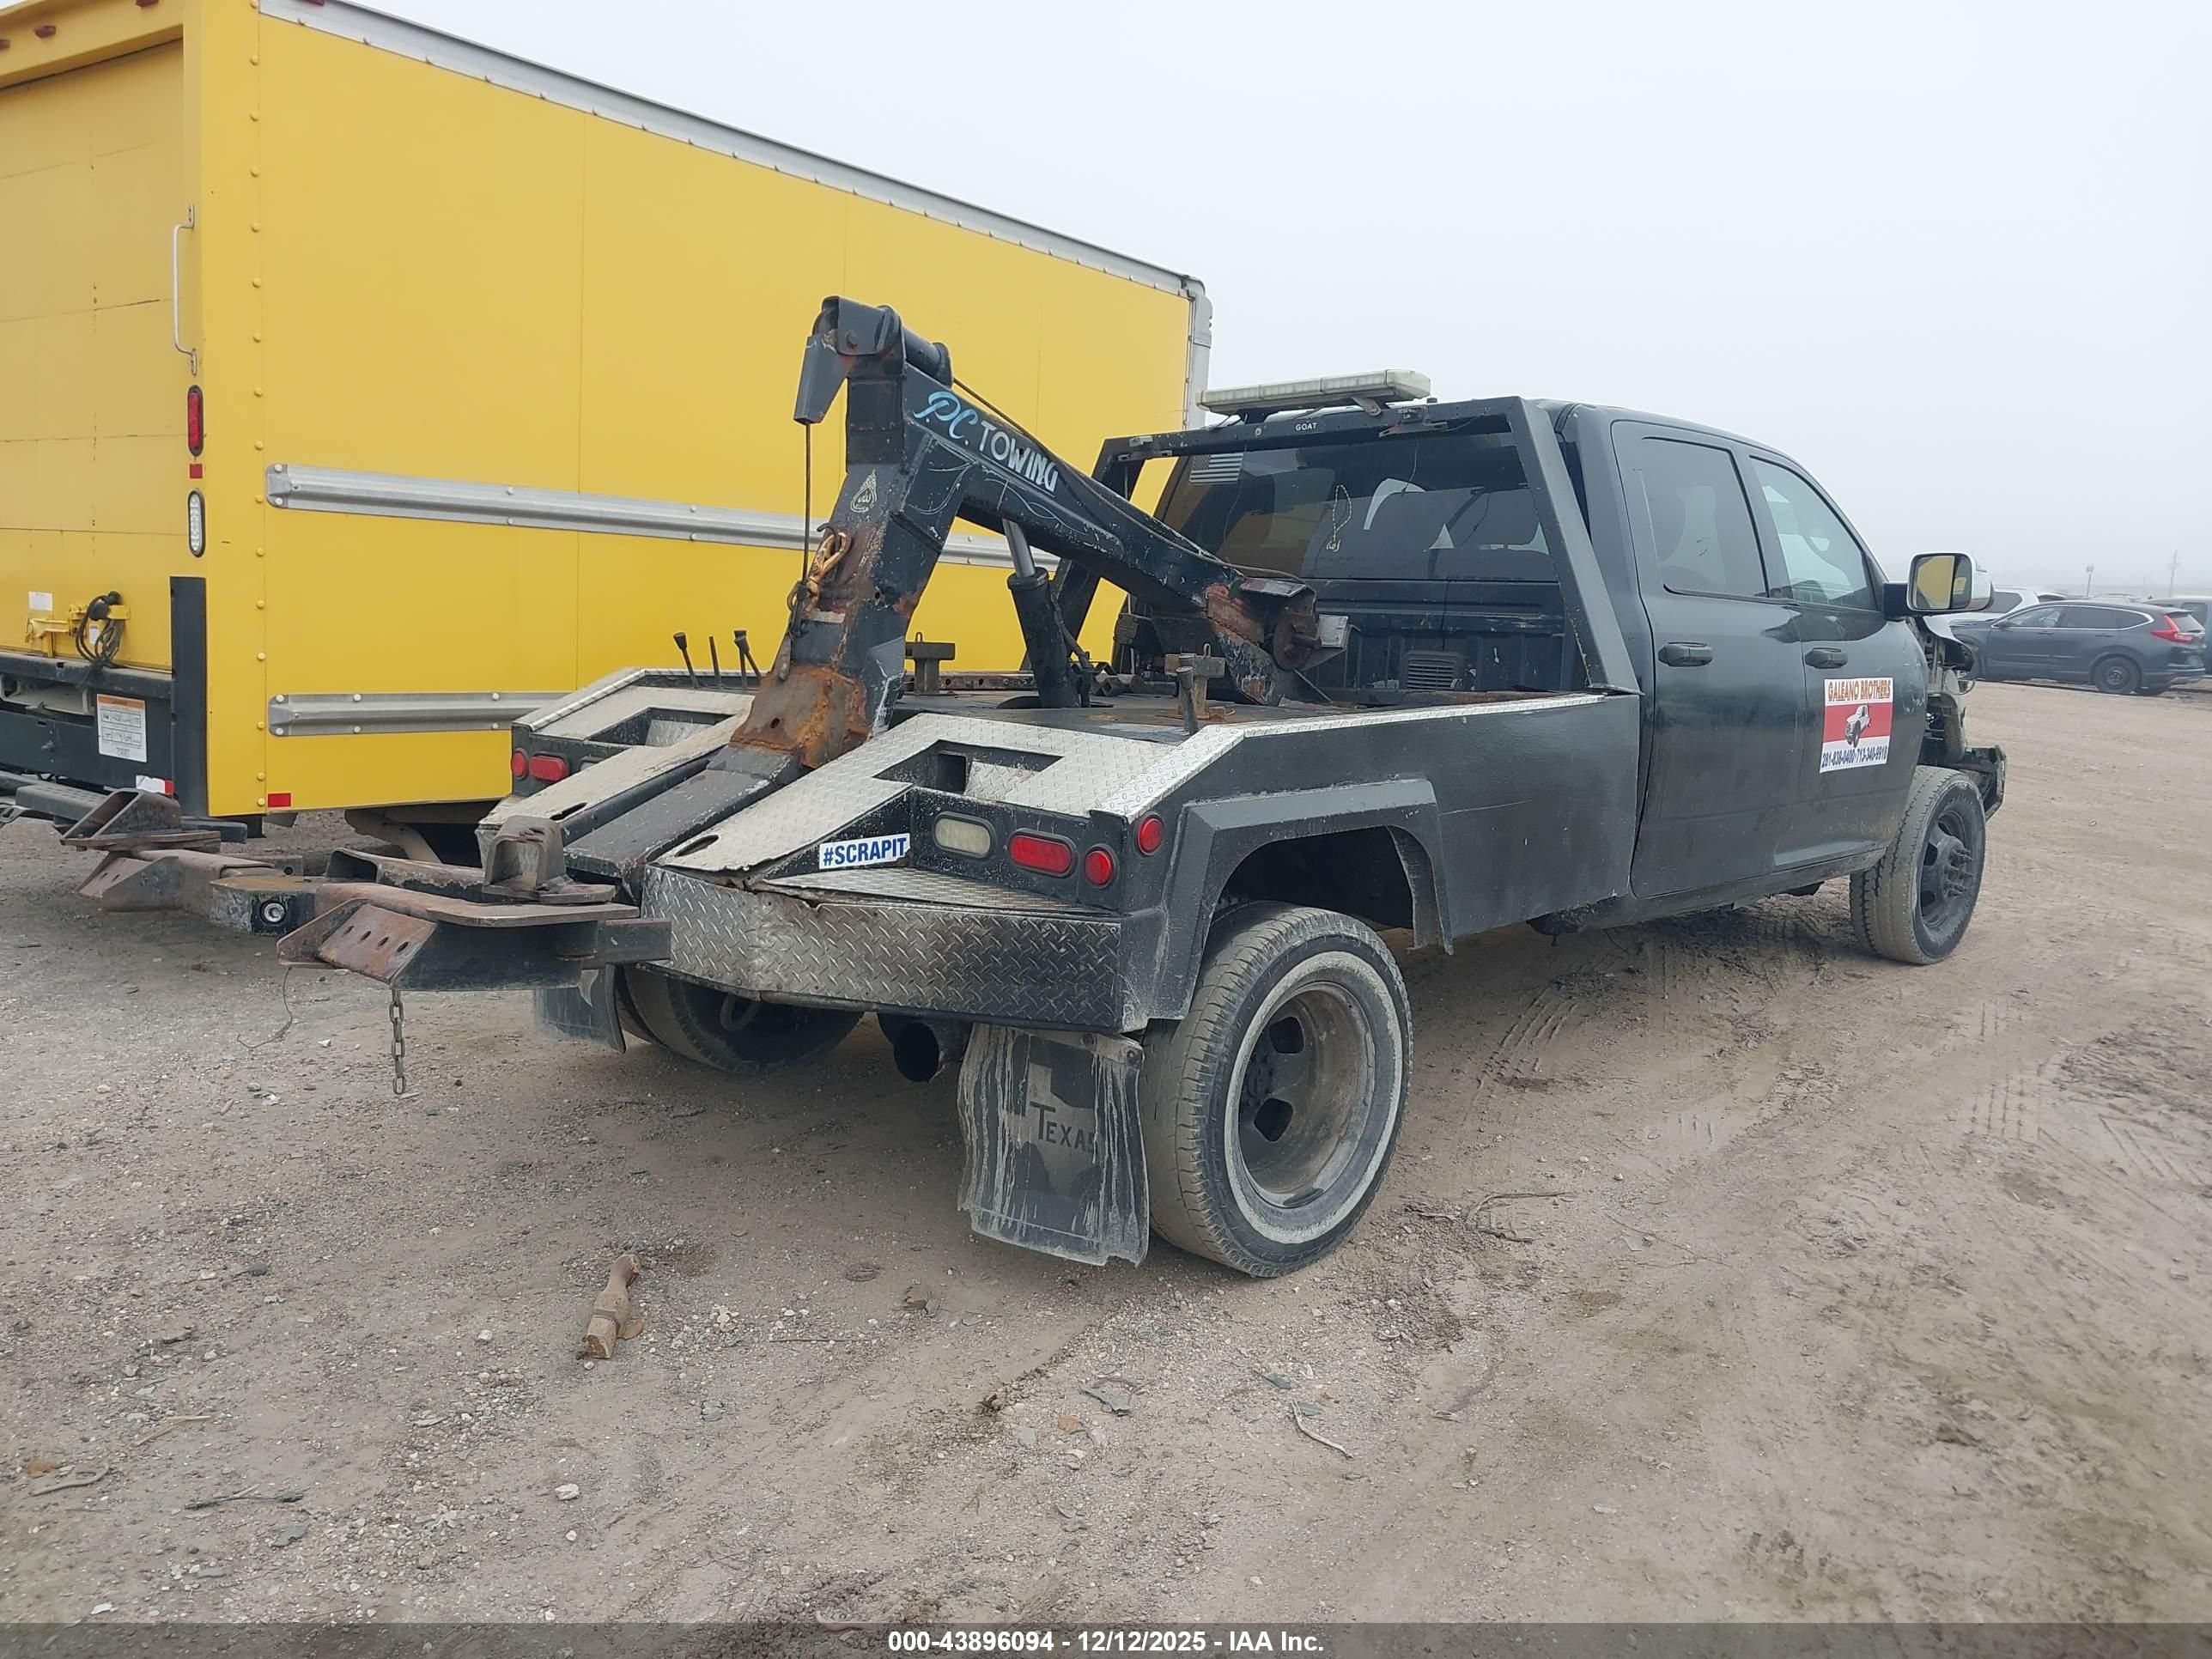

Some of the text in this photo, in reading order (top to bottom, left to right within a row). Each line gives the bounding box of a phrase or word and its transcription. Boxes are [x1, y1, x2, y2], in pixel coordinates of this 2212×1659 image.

[1295, 422, 1318, 432] GOAT
[979, 420, 1059, 493] TOWING
[1827, 678, 1891, 702] GALEANO BROTHERS
[823, 838, 907, 866] #SCRAPIT
